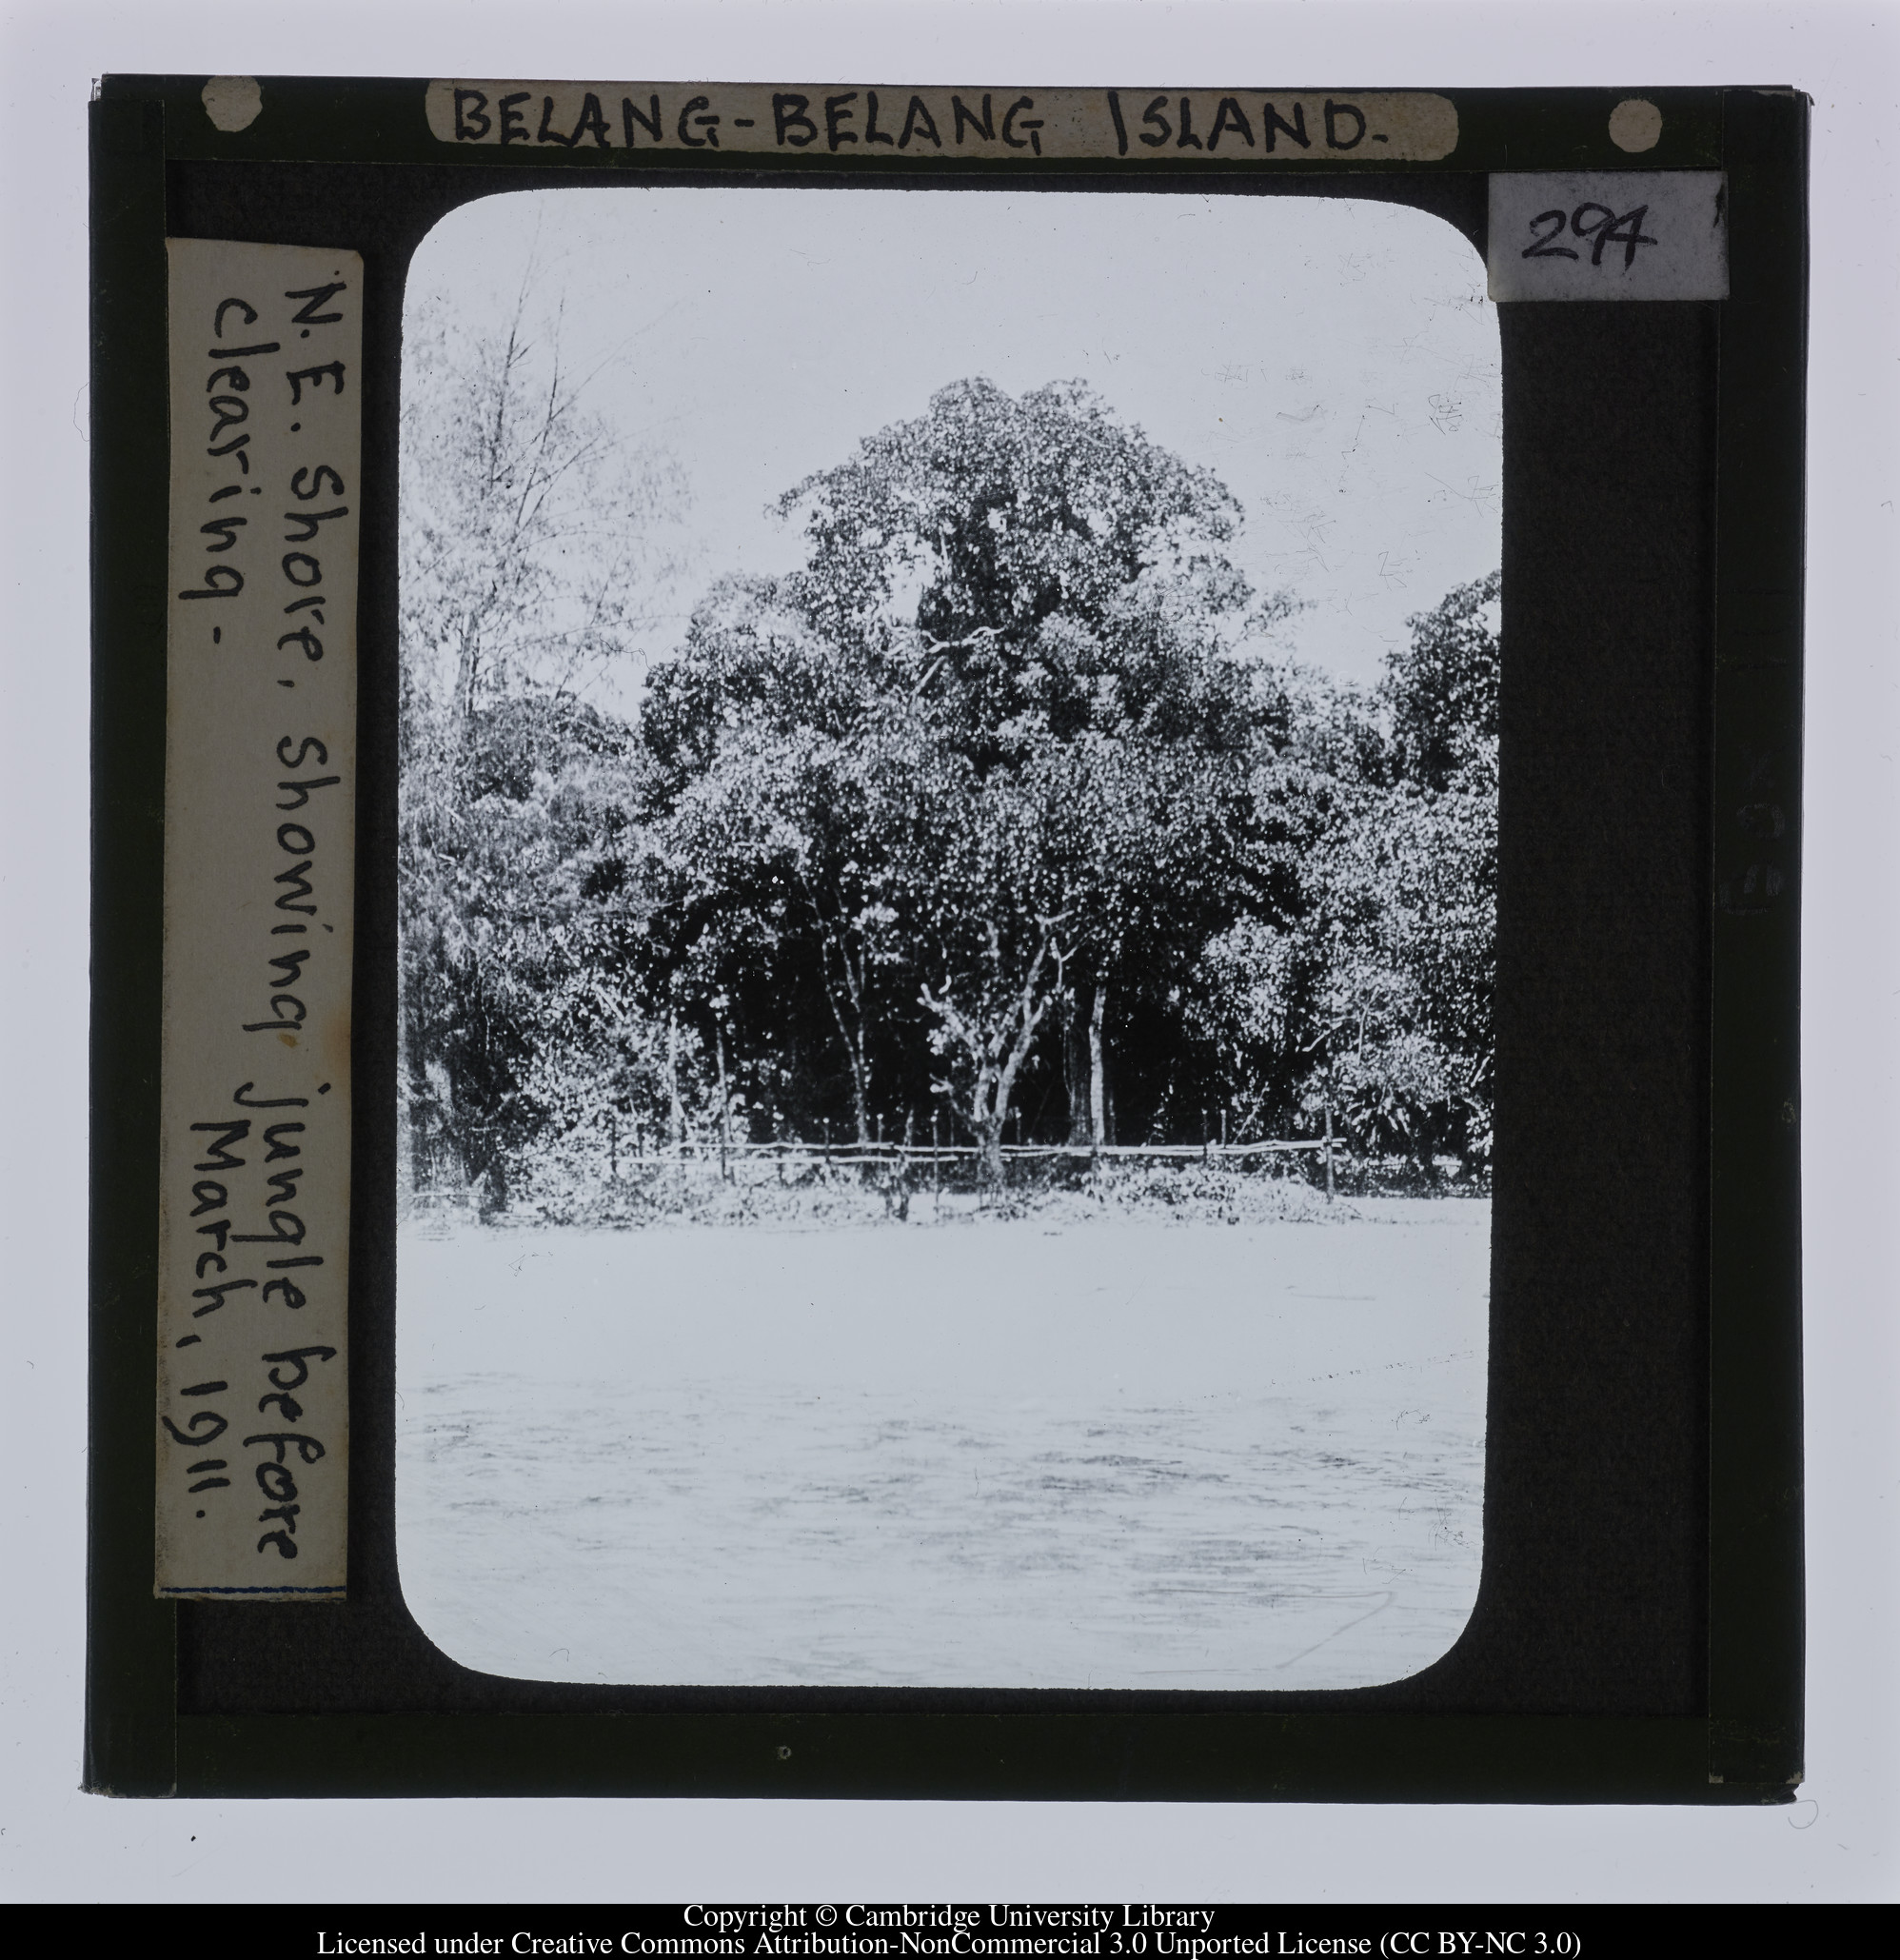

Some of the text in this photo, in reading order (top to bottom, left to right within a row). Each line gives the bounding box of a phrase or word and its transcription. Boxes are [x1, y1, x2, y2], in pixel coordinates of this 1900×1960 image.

[454, 88, 1044, 155] BELANG-BELANG
[1522, 202, 1657, 270] 294
[277, 465, 348, 687] shore,
[242, 735, 342, 1032] showing
[230, 1082, 331, 1310] jungle
[162, 1119, 258, 1518] March, 1911.
[243, 1346, 337, 1559] before
